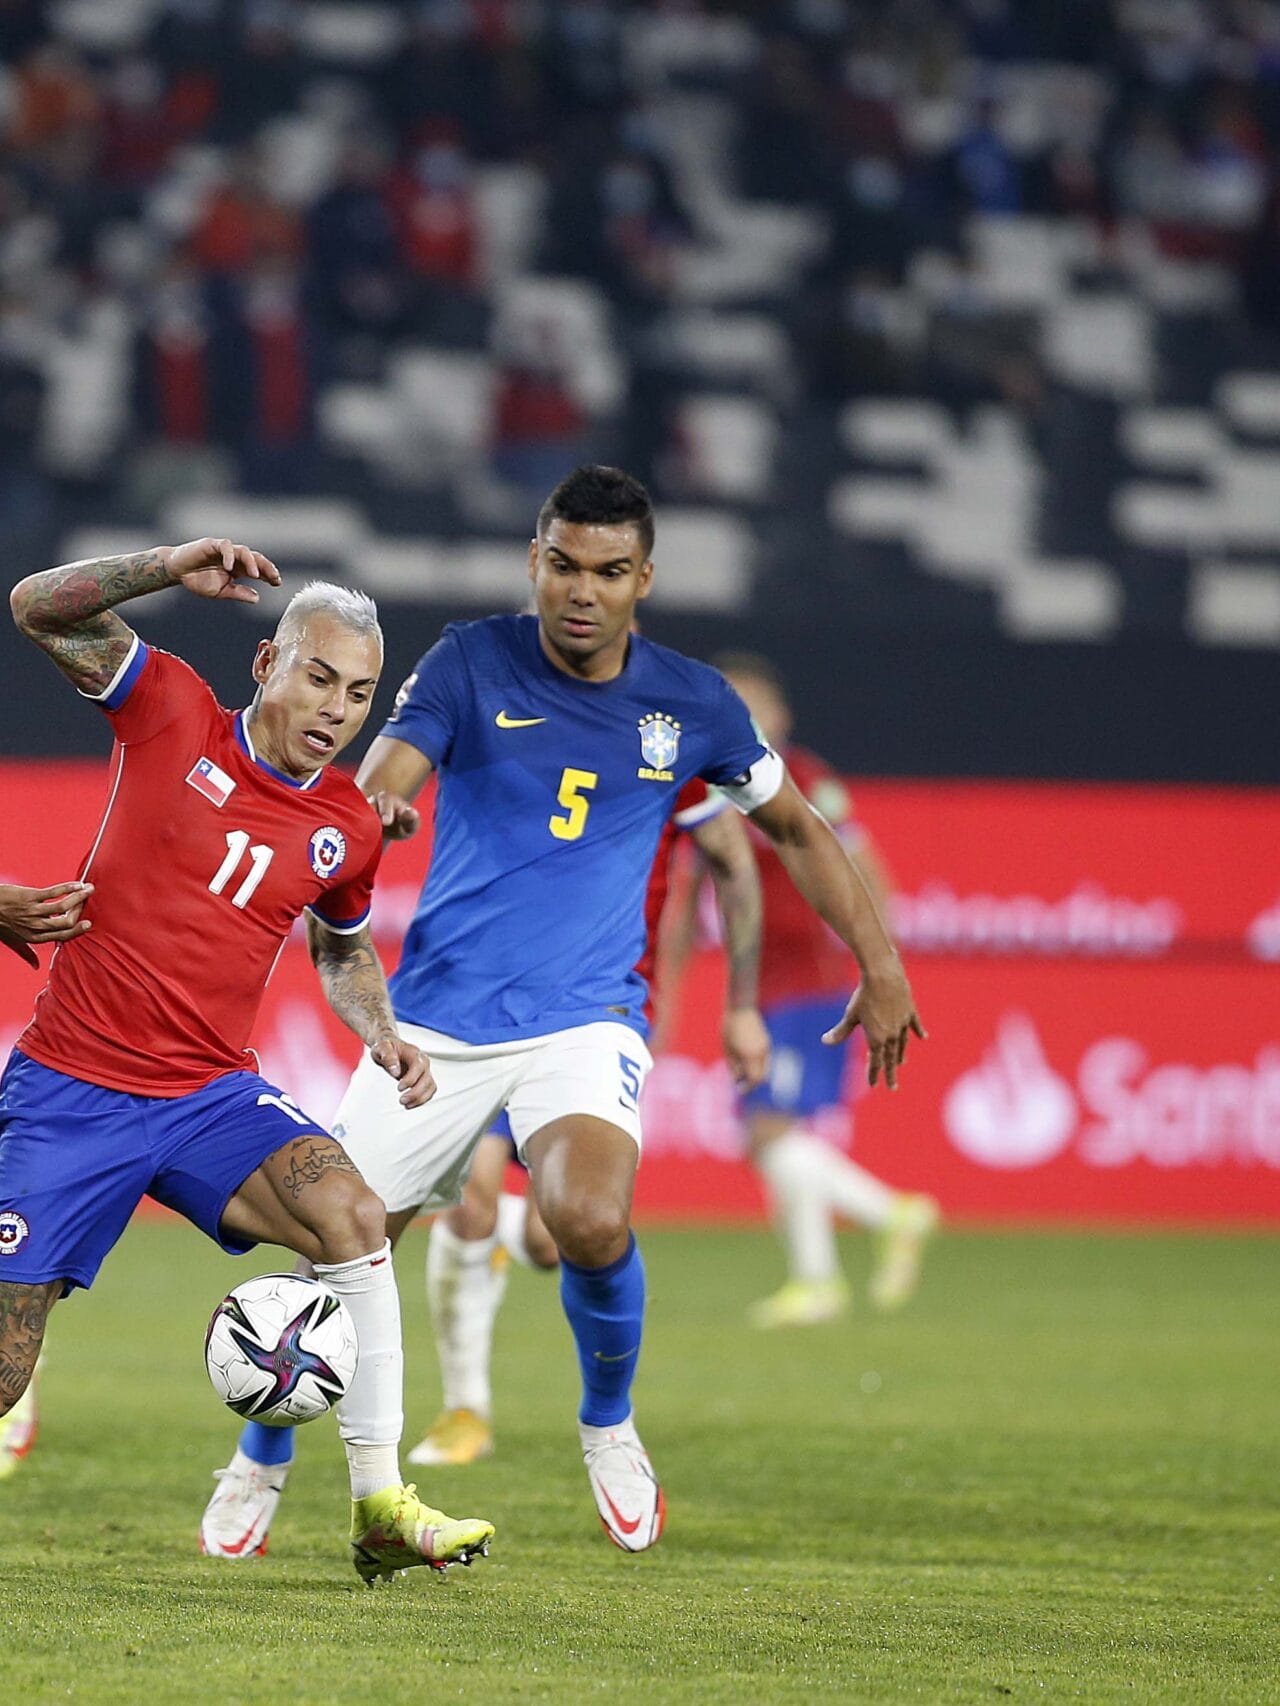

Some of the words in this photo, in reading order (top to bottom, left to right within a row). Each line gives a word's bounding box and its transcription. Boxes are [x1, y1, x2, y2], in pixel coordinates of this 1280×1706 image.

[549, 767, 598, 841] 5
[637, 767, 675, 782] BRASIL
[208, 829, 275, 910] 11
